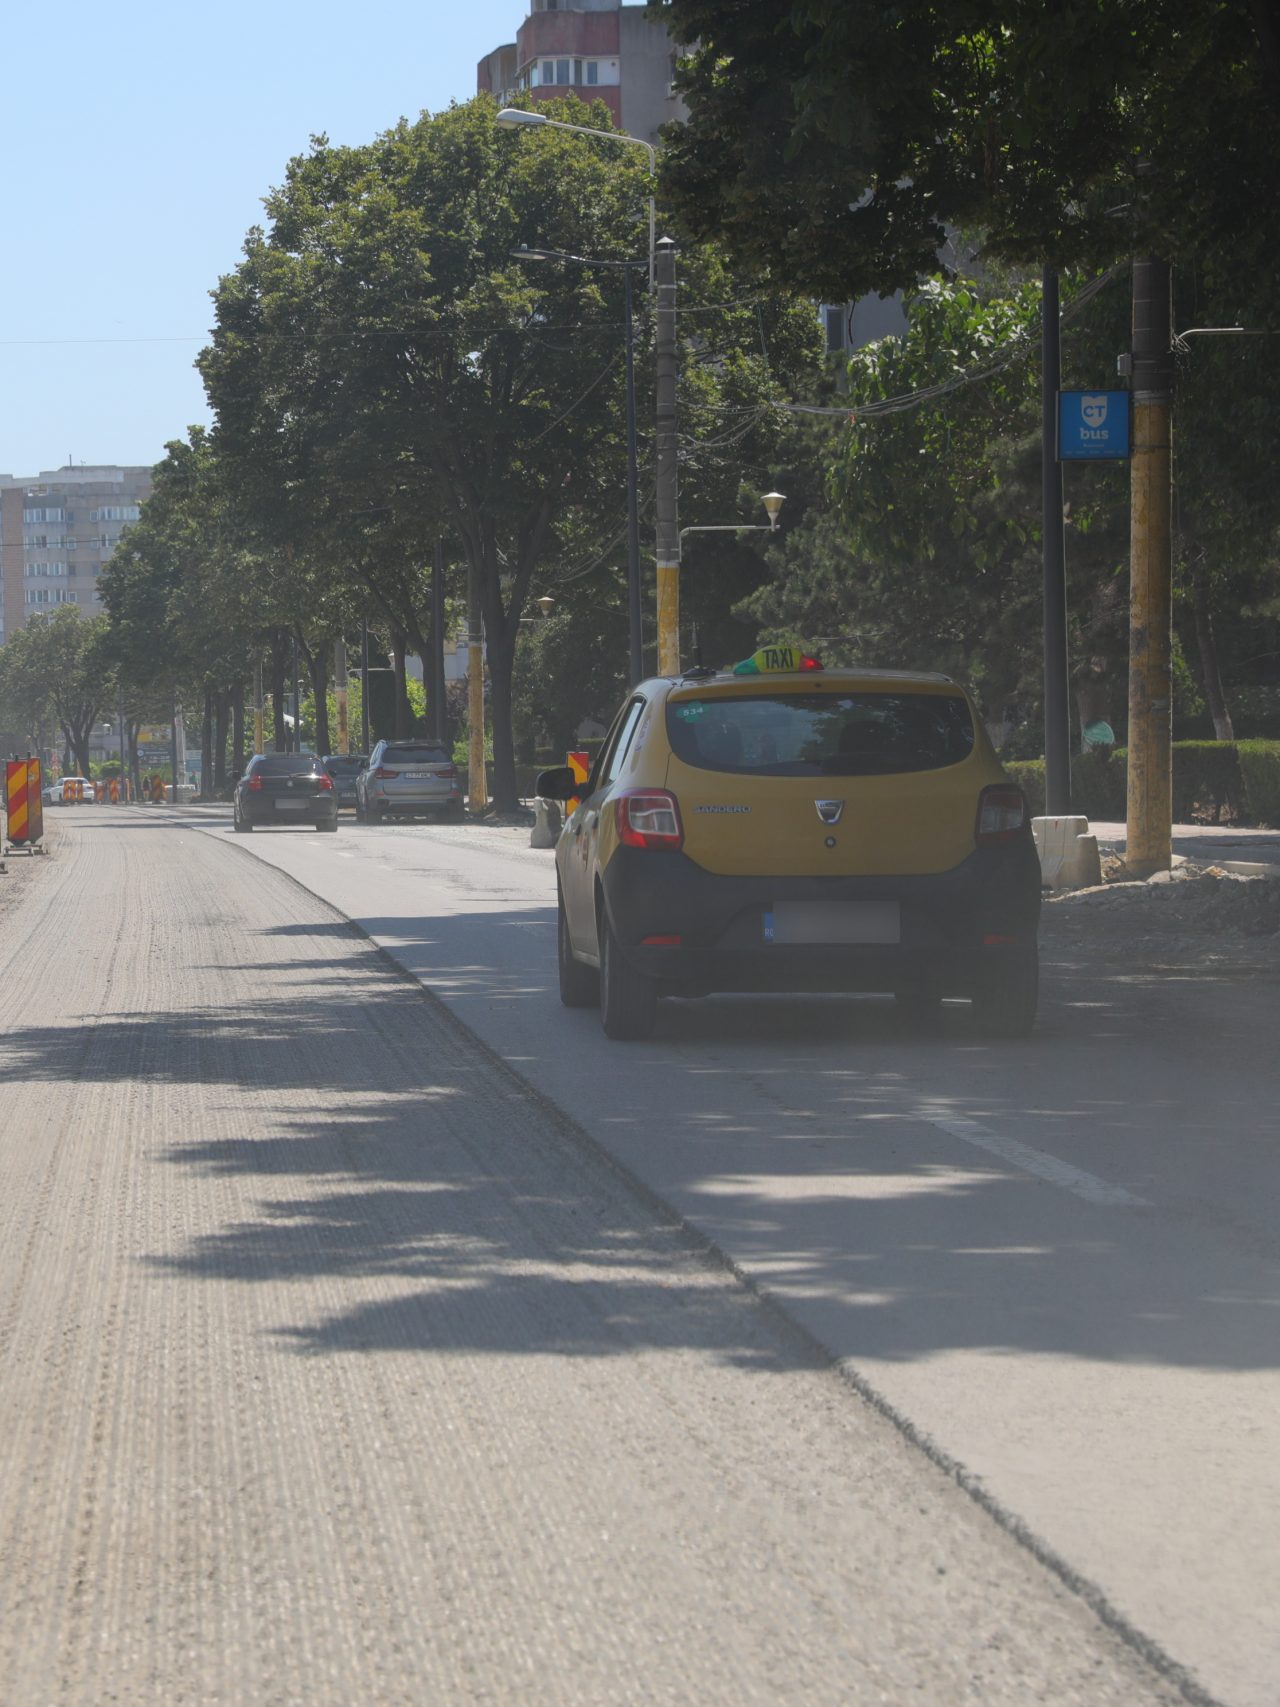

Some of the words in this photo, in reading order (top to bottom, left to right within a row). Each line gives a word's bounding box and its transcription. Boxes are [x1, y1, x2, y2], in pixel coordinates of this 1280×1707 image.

[1083, 405, 1106, 418] CT
[1080, 427, 1109, 440] bus
[762, 648, 794, 669] TAXI
[694, 805, 752, 814] SANDERO
